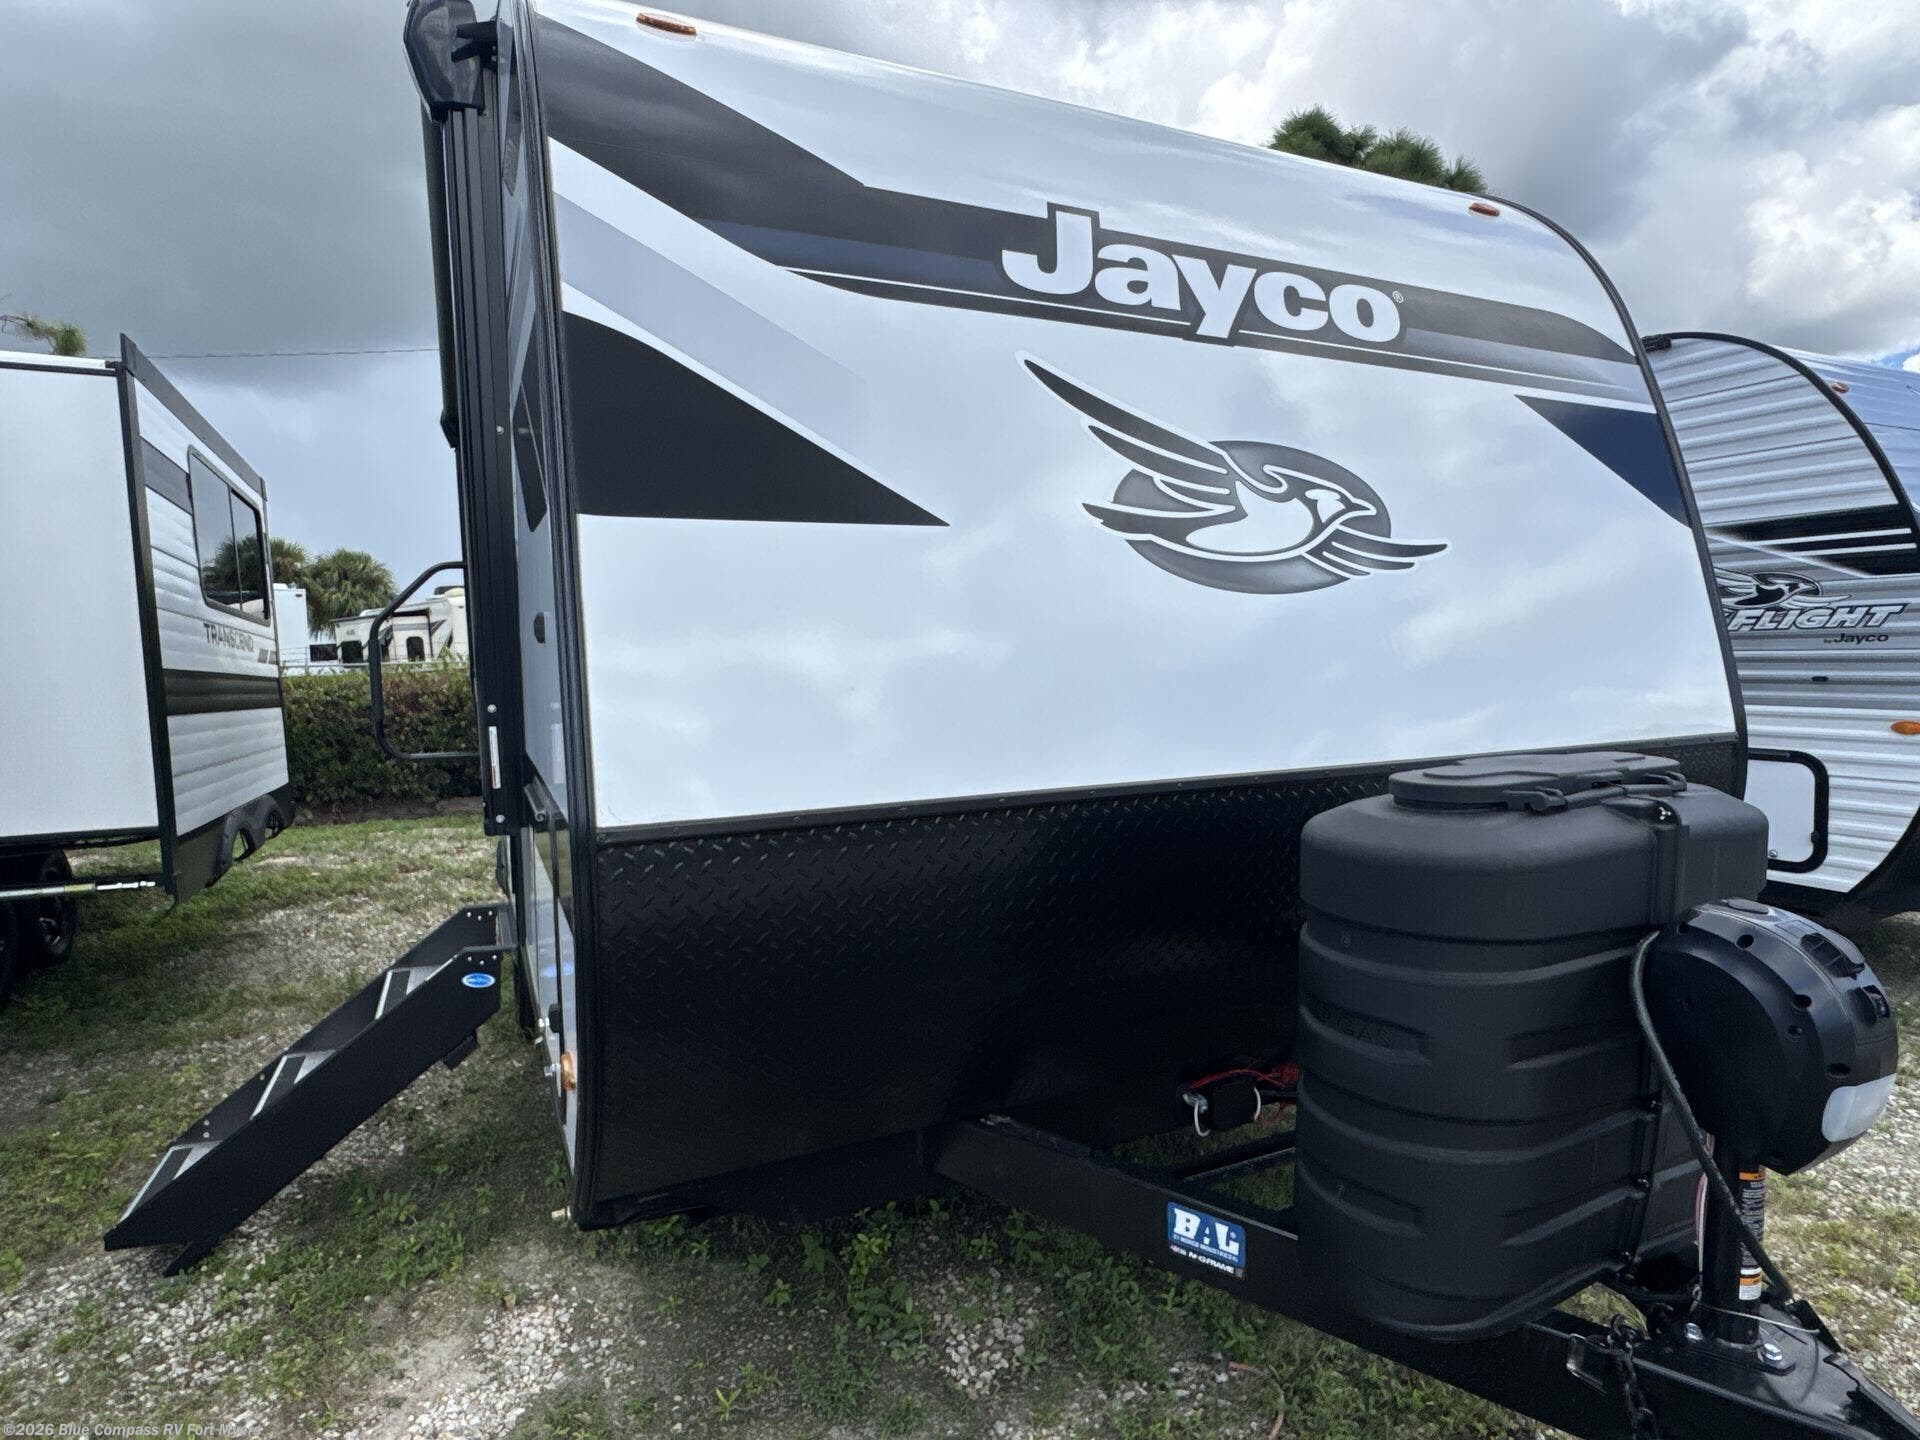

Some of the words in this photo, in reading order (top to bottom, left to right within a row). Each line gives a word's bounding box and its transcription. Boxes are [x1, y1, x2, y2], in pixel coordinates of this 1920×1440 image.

[1727, 603, 1909, 631] FLIGHT
[1833, 632, 1889, 645] Jayco
[1173, 1207, 1240, 1256] BAL
